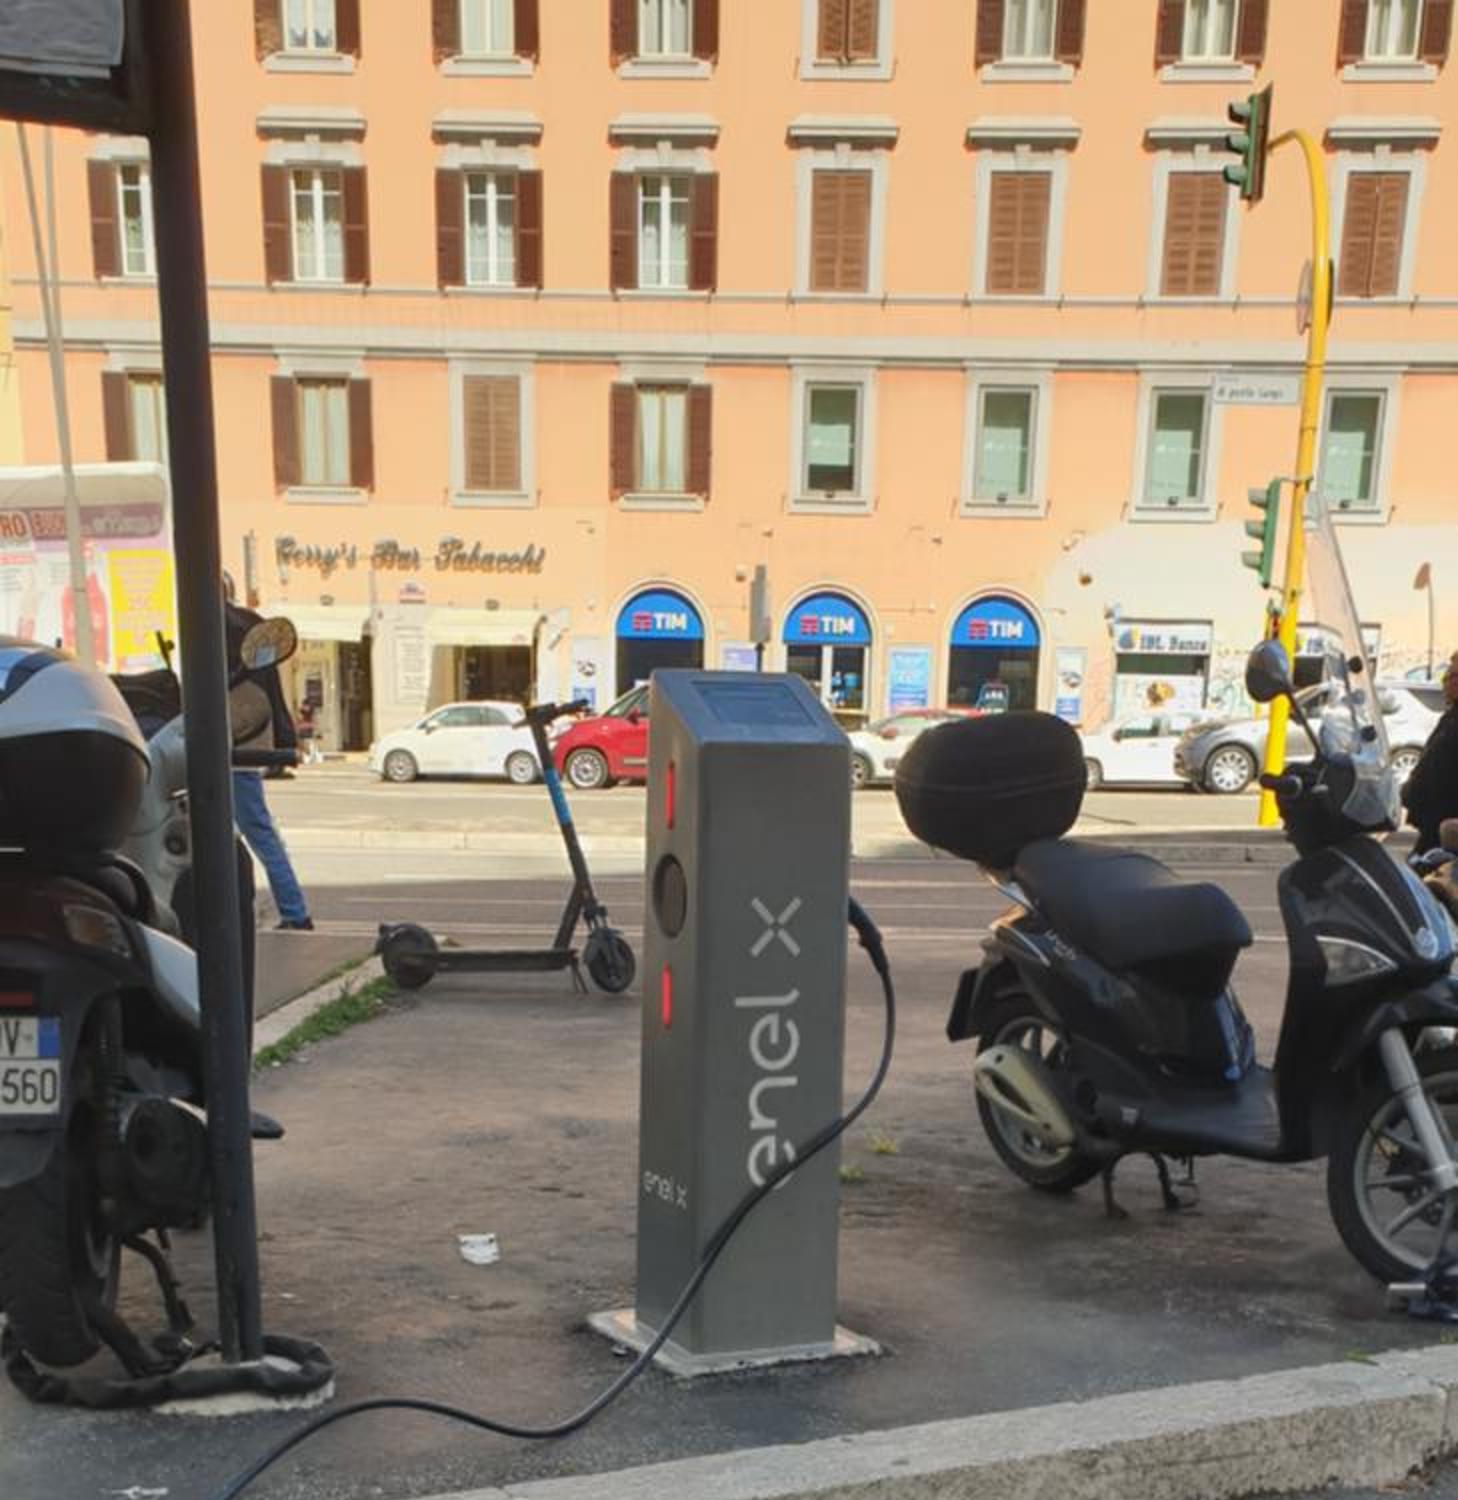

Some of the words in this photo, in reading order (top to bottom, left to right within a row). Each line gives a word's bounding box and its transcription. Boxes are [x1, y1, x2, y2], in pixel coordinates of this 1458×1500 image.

[654, 612, 688, 630] TIM
[822, 616, 855, 633] TIM
[990, 619, 1023, 638] TIM
[2, 1068, 57, 1105] 560
[733, 988, 801, 1190] enel
